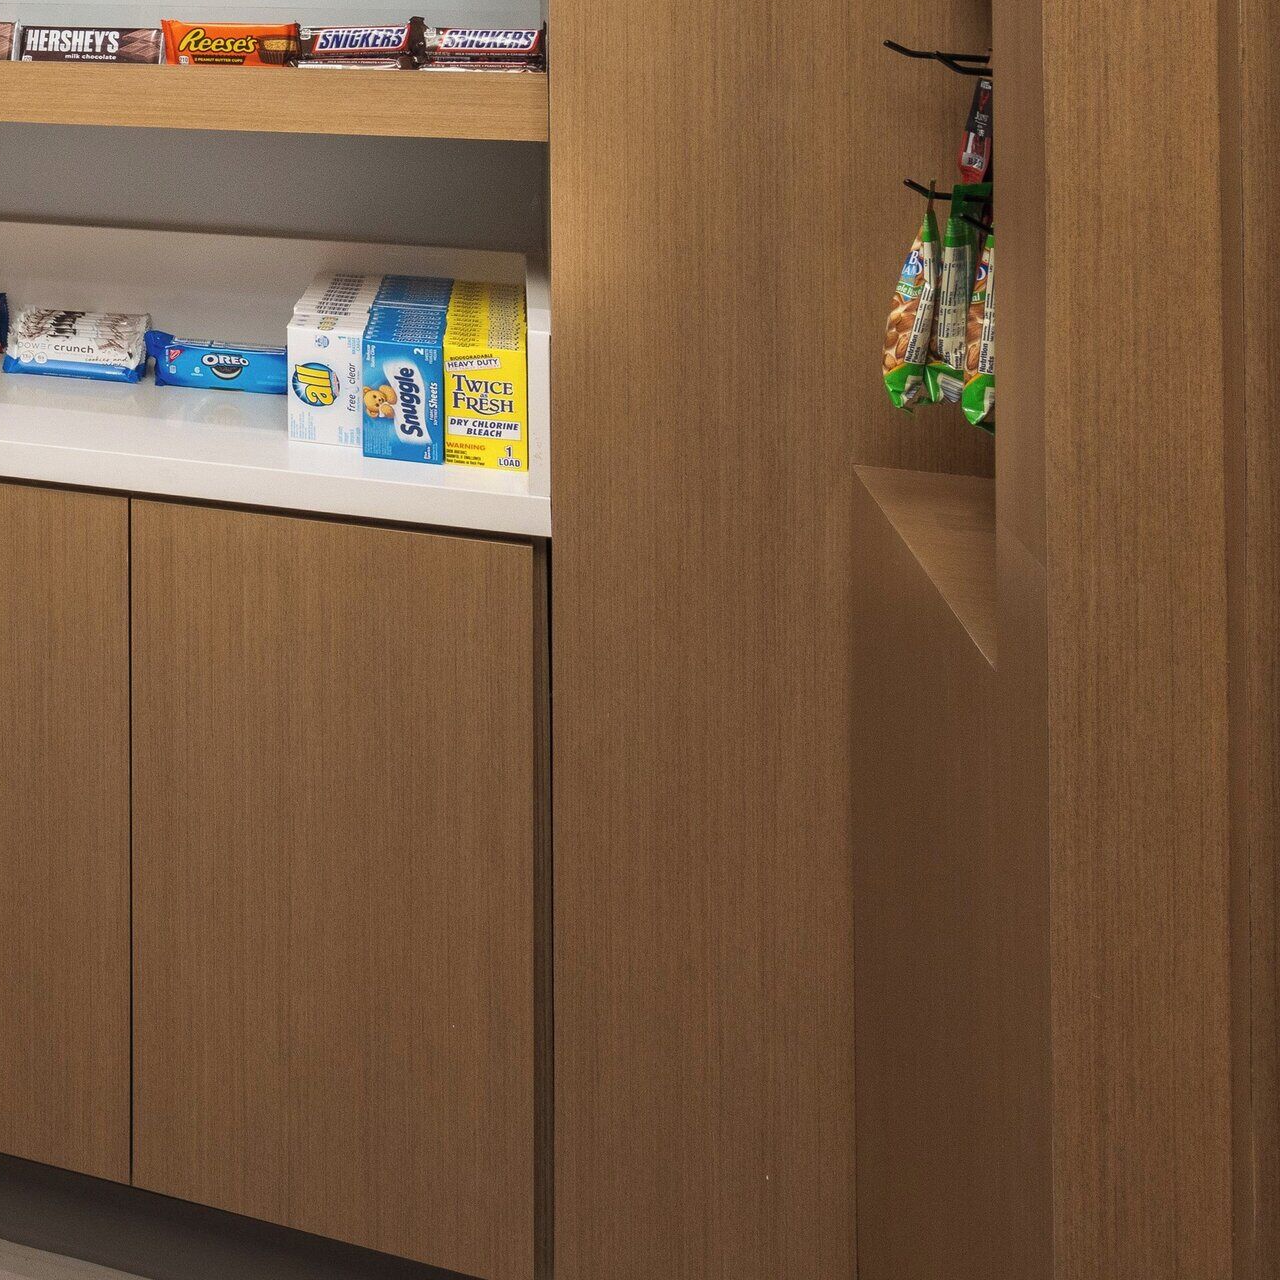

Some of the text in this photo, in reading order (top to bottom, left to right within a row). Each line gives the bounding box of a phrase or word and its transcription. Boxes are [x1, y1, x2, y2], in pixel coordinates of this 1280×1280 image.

[26, 28, 119, 53] HERSHEY'S
[178, 27, 259, 52] Reese's
[319, 28, 407, 49] SNICKERS
[443, 29, 537, 50] SNICKERS
[81, 53, 117, 61] chocolate
[179, 56, 189, 64] 210
[17, 341, 94, 354] power crunch
[413, 347, 424, 355] 2
[905, 334, 918, 362] Nutrition
[202, 354, 249, 367] OREO
[448, 358, 498, 369] HEAVY DUTY
[979, 343, 989, 373] Nutrition
[986, 355, 995, 374] Facts
[347, 363, 357, 385] clear
[295, 364, 335, 406] all
[452, 373, 514, 396] TWICE
[347, 394, 356, 413] free
[393, 367, 424, 438] Snuggle
[429, 382, 438, 410] Sheets
[452, 391, 514, 416] FRESH
[449, 417, 520, 431] DRY CHLORINE
[466, 428, 503, 438] BLEACH
[446, 441, 486, 451] WARNING
[505, 446, 513, 458] 1
[498, 458, 521, 468] LOAD
